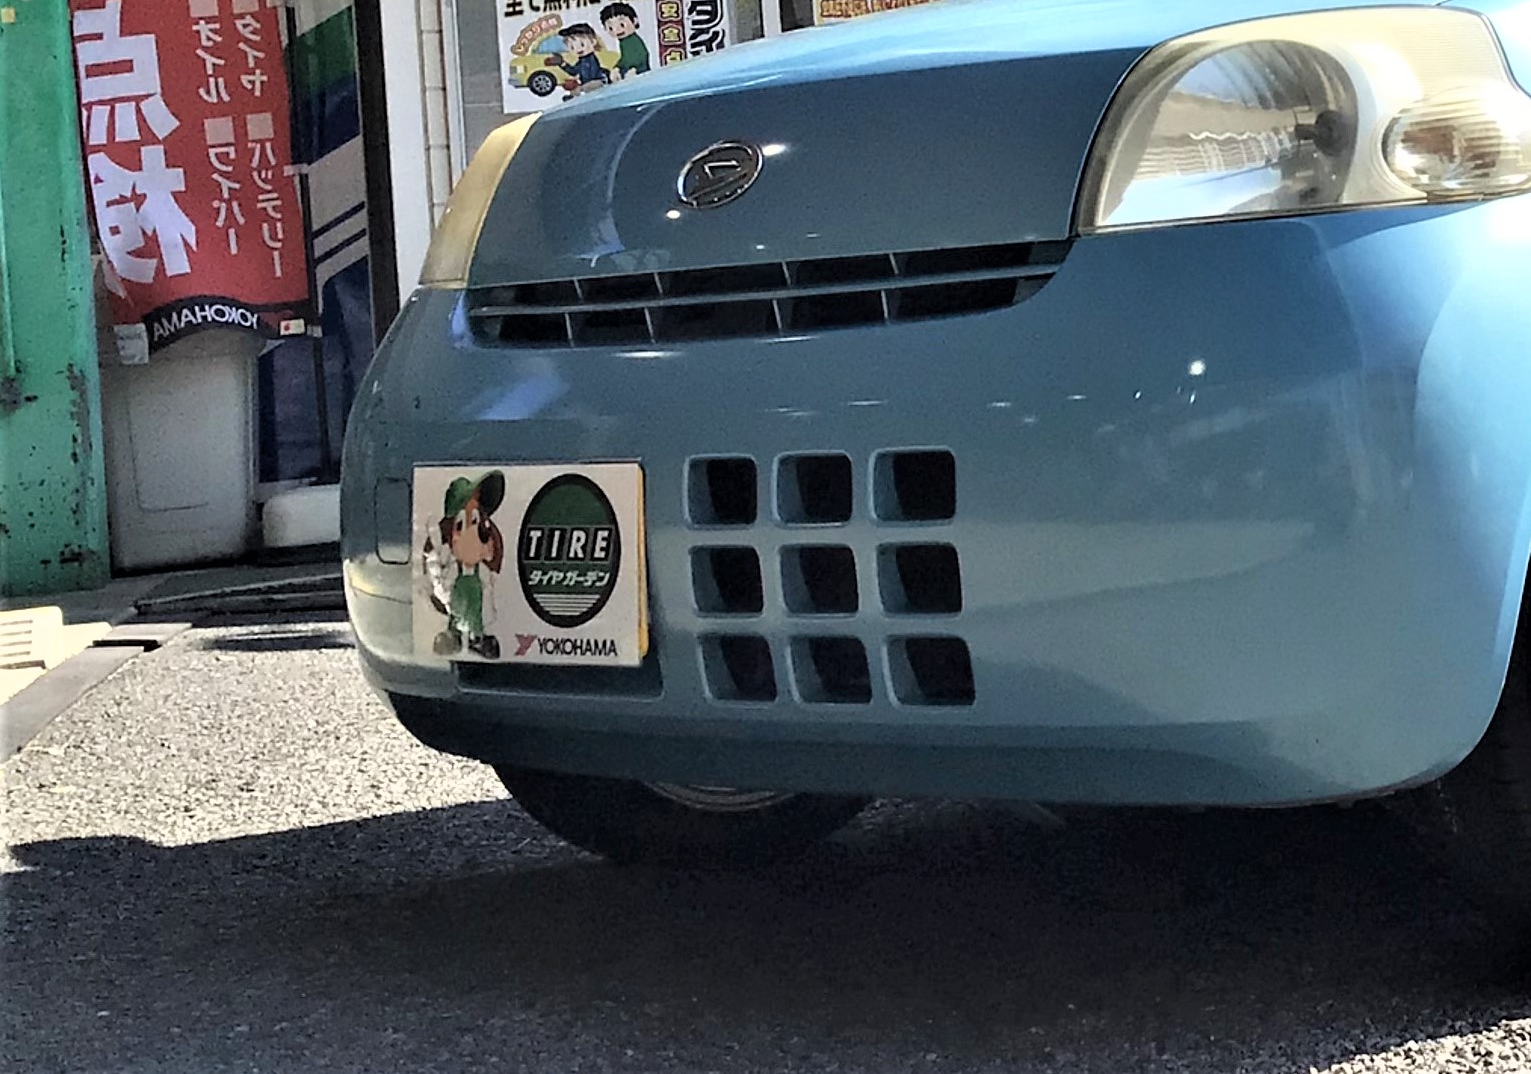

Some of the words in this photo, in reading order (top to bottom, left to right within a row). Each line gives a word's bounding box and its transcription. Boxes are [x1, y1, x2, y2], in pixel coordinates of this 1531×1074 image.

[529, 529, 609, 558] TIRE
[528, 570, 610, 586] タイヤガーデン
[538, 638, 618, 656] YOKOHAMA
